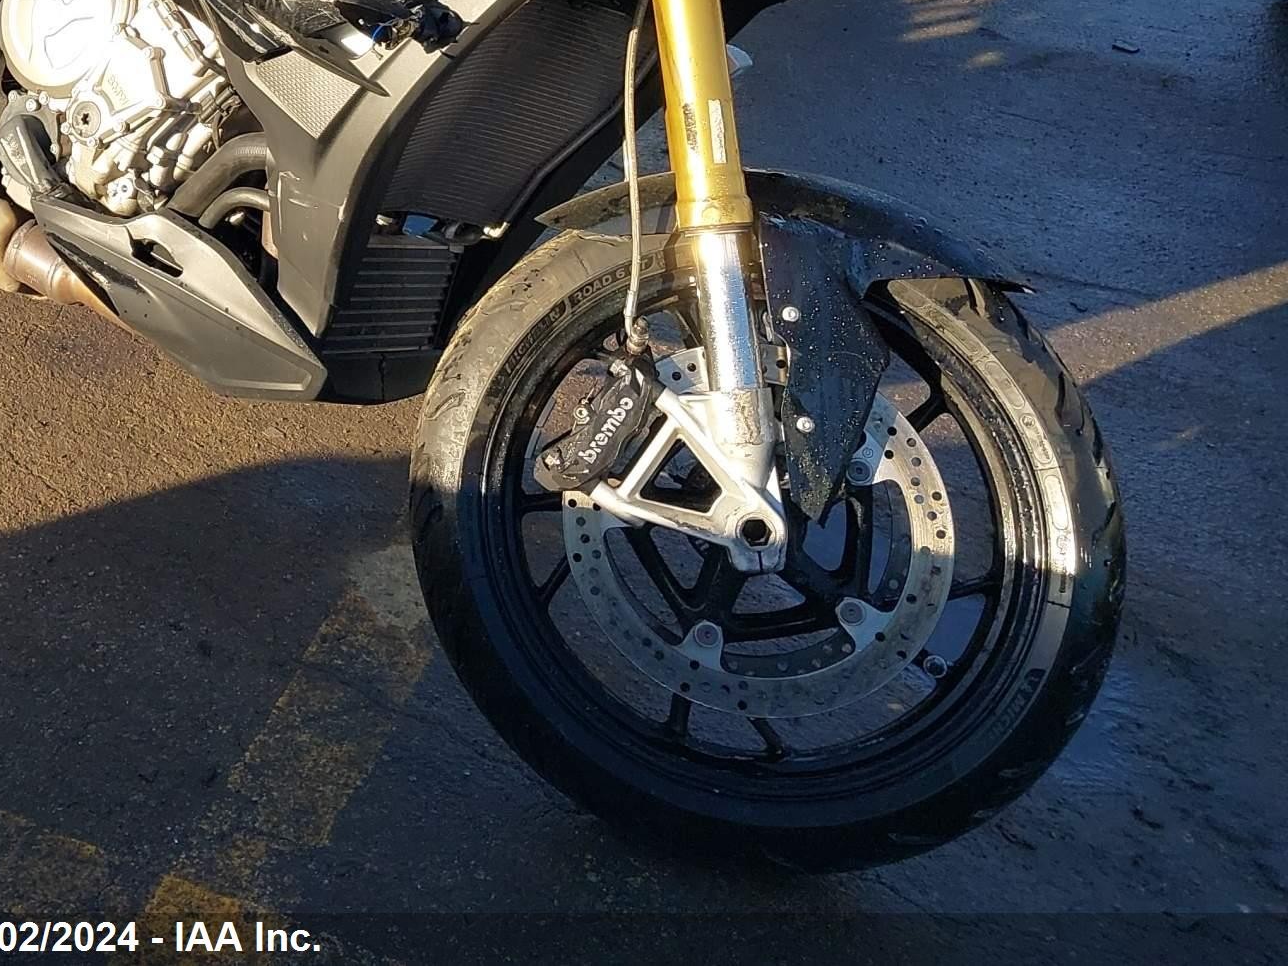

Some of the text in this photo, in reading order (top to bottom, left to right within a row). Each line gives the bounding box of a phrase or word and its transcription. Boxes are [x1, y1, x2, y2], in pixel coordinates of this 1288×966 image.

[505, 305, 562, 374] MICHELIN
[573, 274, 612, 306] ROAD
[615, 267, 625, 279] 6
[577, 397, 634, 464] brembo
